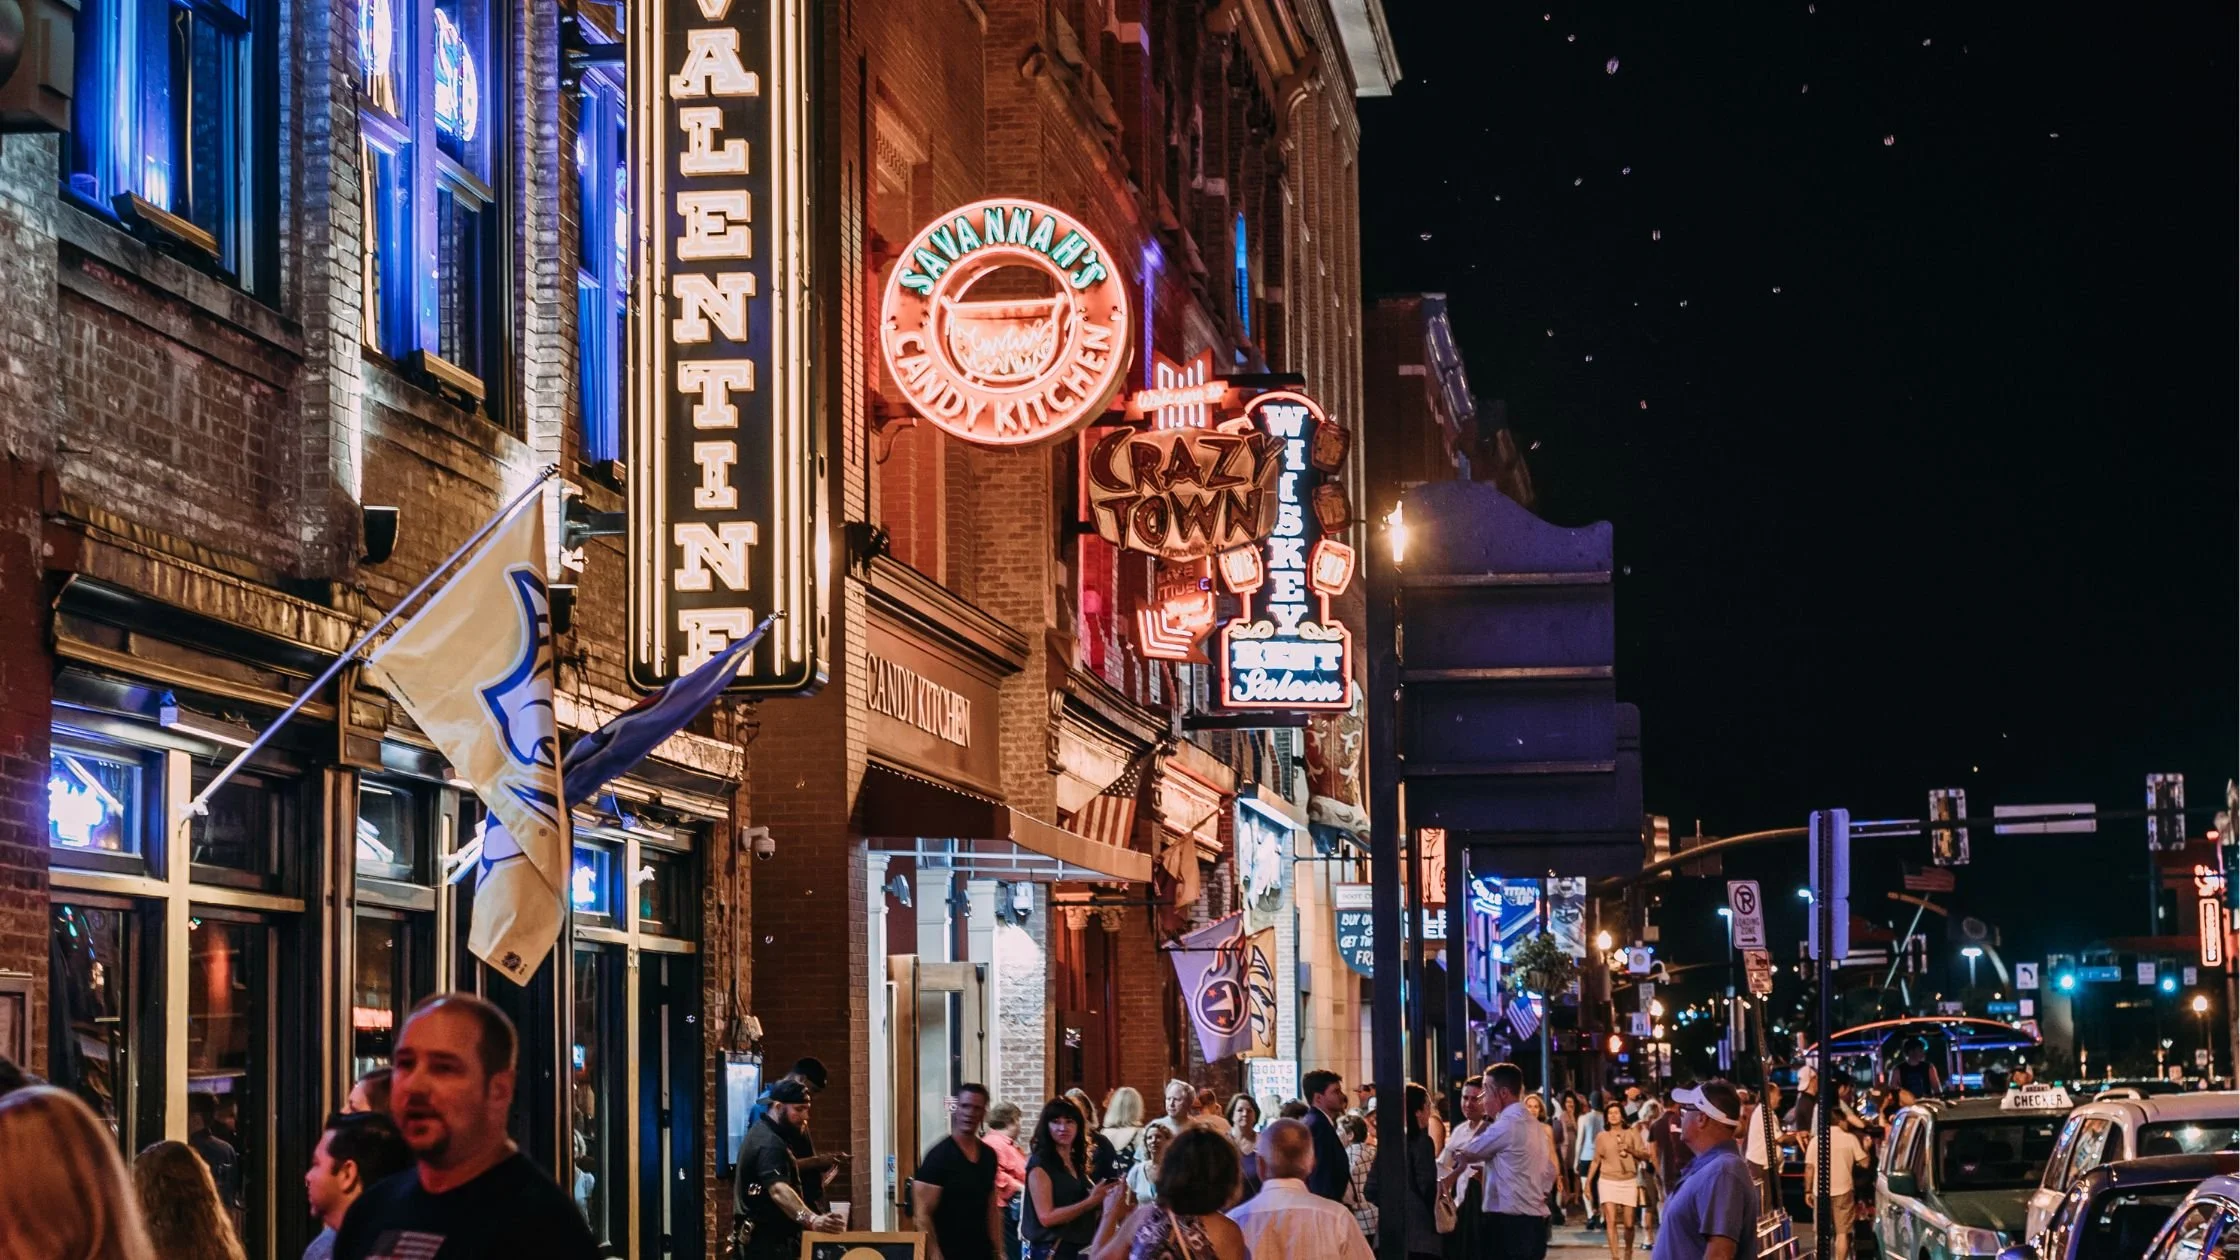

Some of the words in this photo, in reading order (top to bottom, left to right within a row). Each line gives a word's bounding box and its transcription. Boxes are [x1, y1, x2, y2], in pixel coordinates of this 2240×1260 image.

[899, 206, 1108, 296] SAVANNAH'S
[895, 331, 988, 433] CANDY
[995, 322, 1113, 435] KITCHEN
[1088, 426, 1288, 494] CRAZY
[1095, 487, 1264, 550] TOWN
[1232, 668, 1344, 701] Saloon
[866, 652, 914, 724] CANDY
[917, 673, 971, 749] KITCHEN
[1503, 886, 1535, 897] TITAN
[1516, 895, 1534, 906] UP
[1341, 913, 1361, 926] BUY
[1361, 913, 1373, 926] ON
[1364, 925, 1373, 936] &
[1340, 935, 1358, 949] GET
[1359, 935, 1373, 948] TW
[1253, 1063, 1294, 1075] BOOTS
